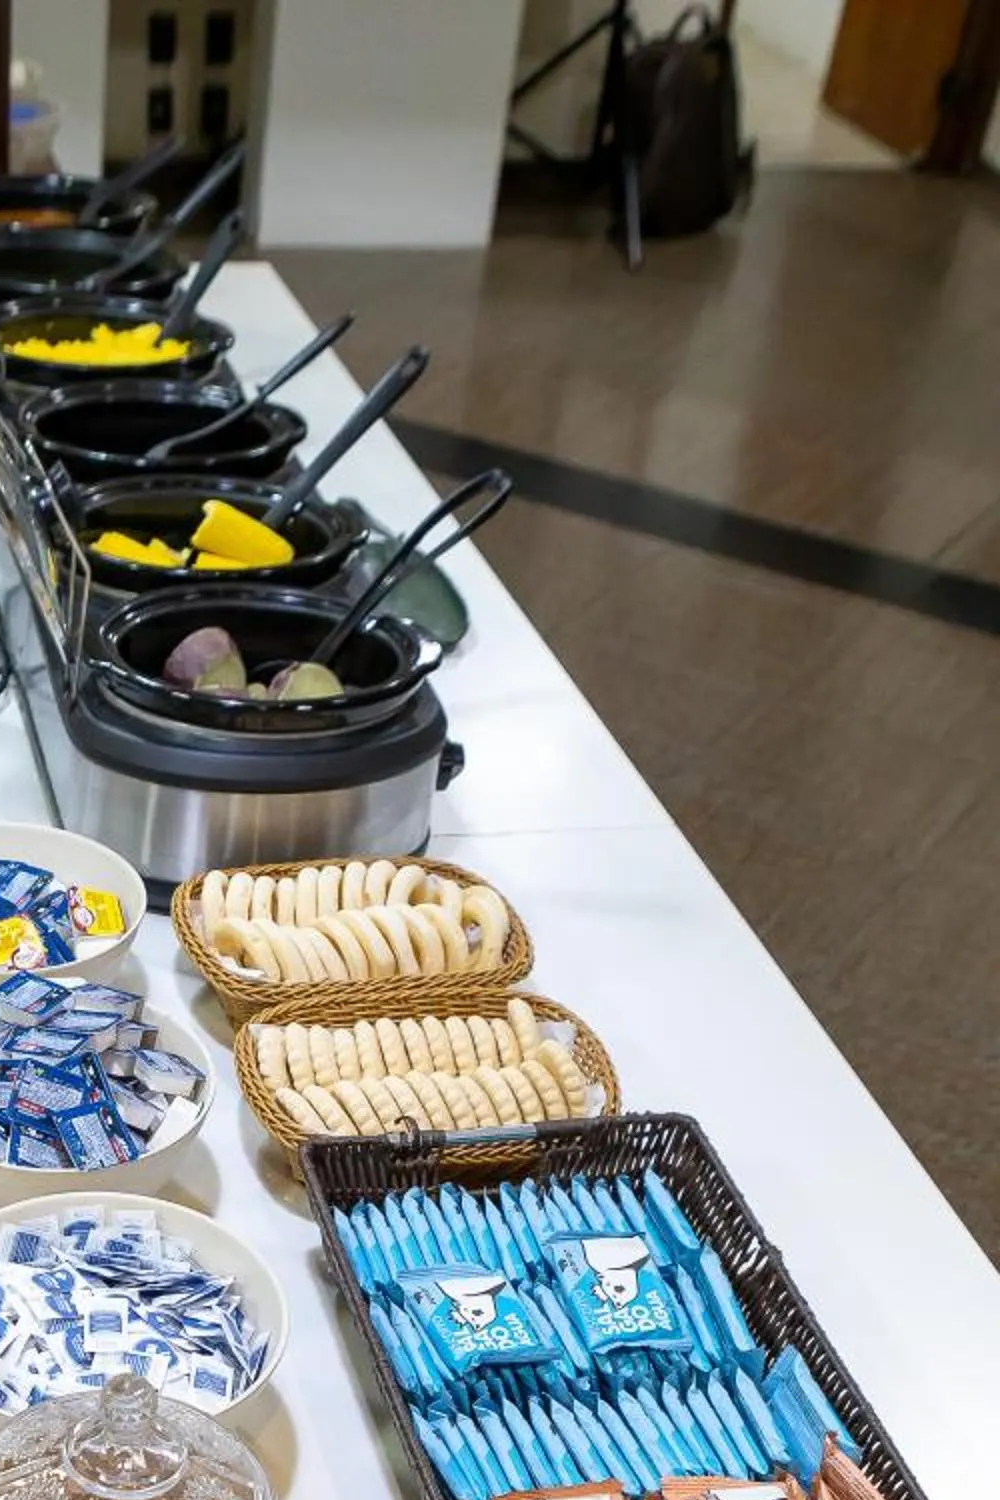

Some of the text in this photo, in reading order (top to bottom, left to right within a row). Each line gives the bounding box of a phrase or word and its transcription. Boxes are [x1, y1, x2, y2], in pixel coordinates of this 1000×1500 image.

[594, 1303, 620, 1335] SAL
[614, 1308, 639, 1333] GA
[631, 1305, 656, 1332] DO
